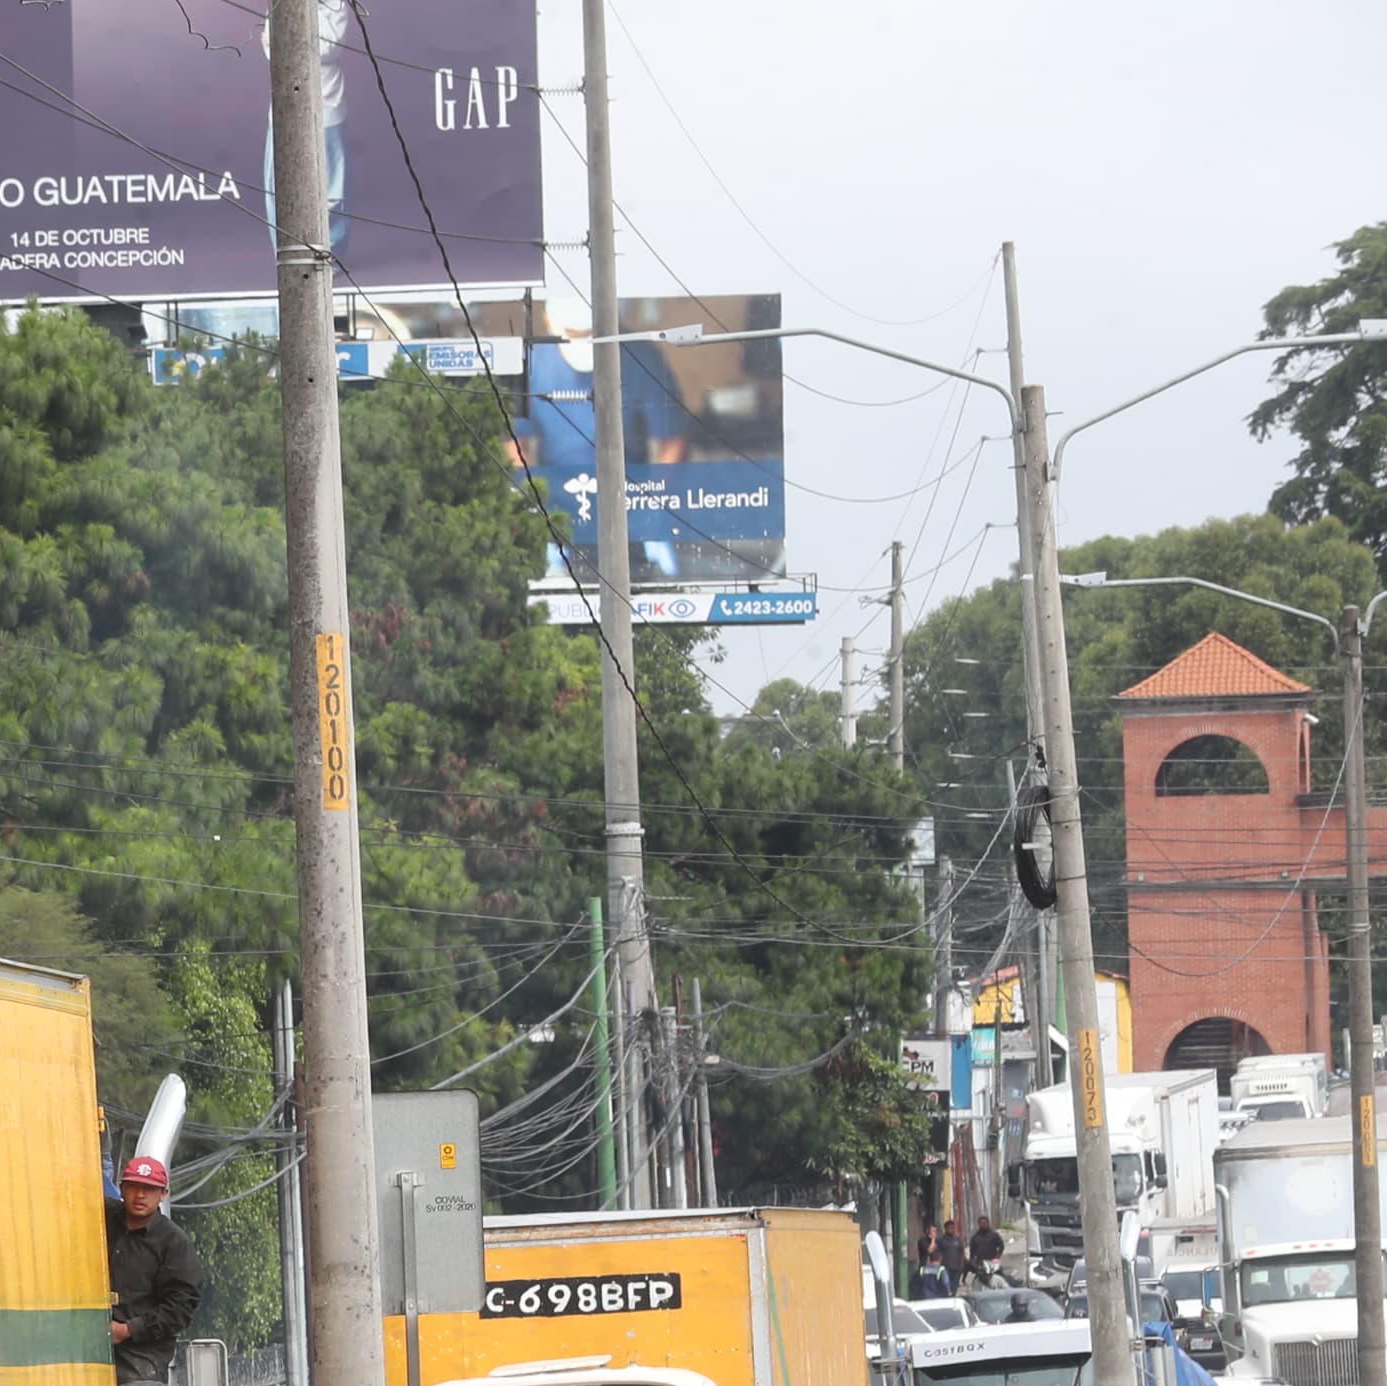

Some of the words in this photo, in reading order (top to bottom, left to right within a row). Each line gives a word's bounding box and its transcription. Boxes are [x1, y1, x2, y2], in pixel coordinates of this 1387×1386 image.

[434, 66, 518, 131] GAP
[33, 172, 241, 206] GUATEMALA
[10, 232, 31, 248] 14
[34, 230, 60, 247] DE
[62, 228, 150, 246] OCTUBRE
[63, 246, 185, 269] CONCEPCIÓN
[429, 350, 492, 360] EMISORAS
[429, 359, 474, 369] UNIDAS
[623, 494, 680, 511] errera
[686, 486, 770, 509] Llerandi
[734, 599, 813, 616] 2423-2600
[324, 634, 345, 801] 120100
[485, 1279, 675, 1314] C-698BFP
